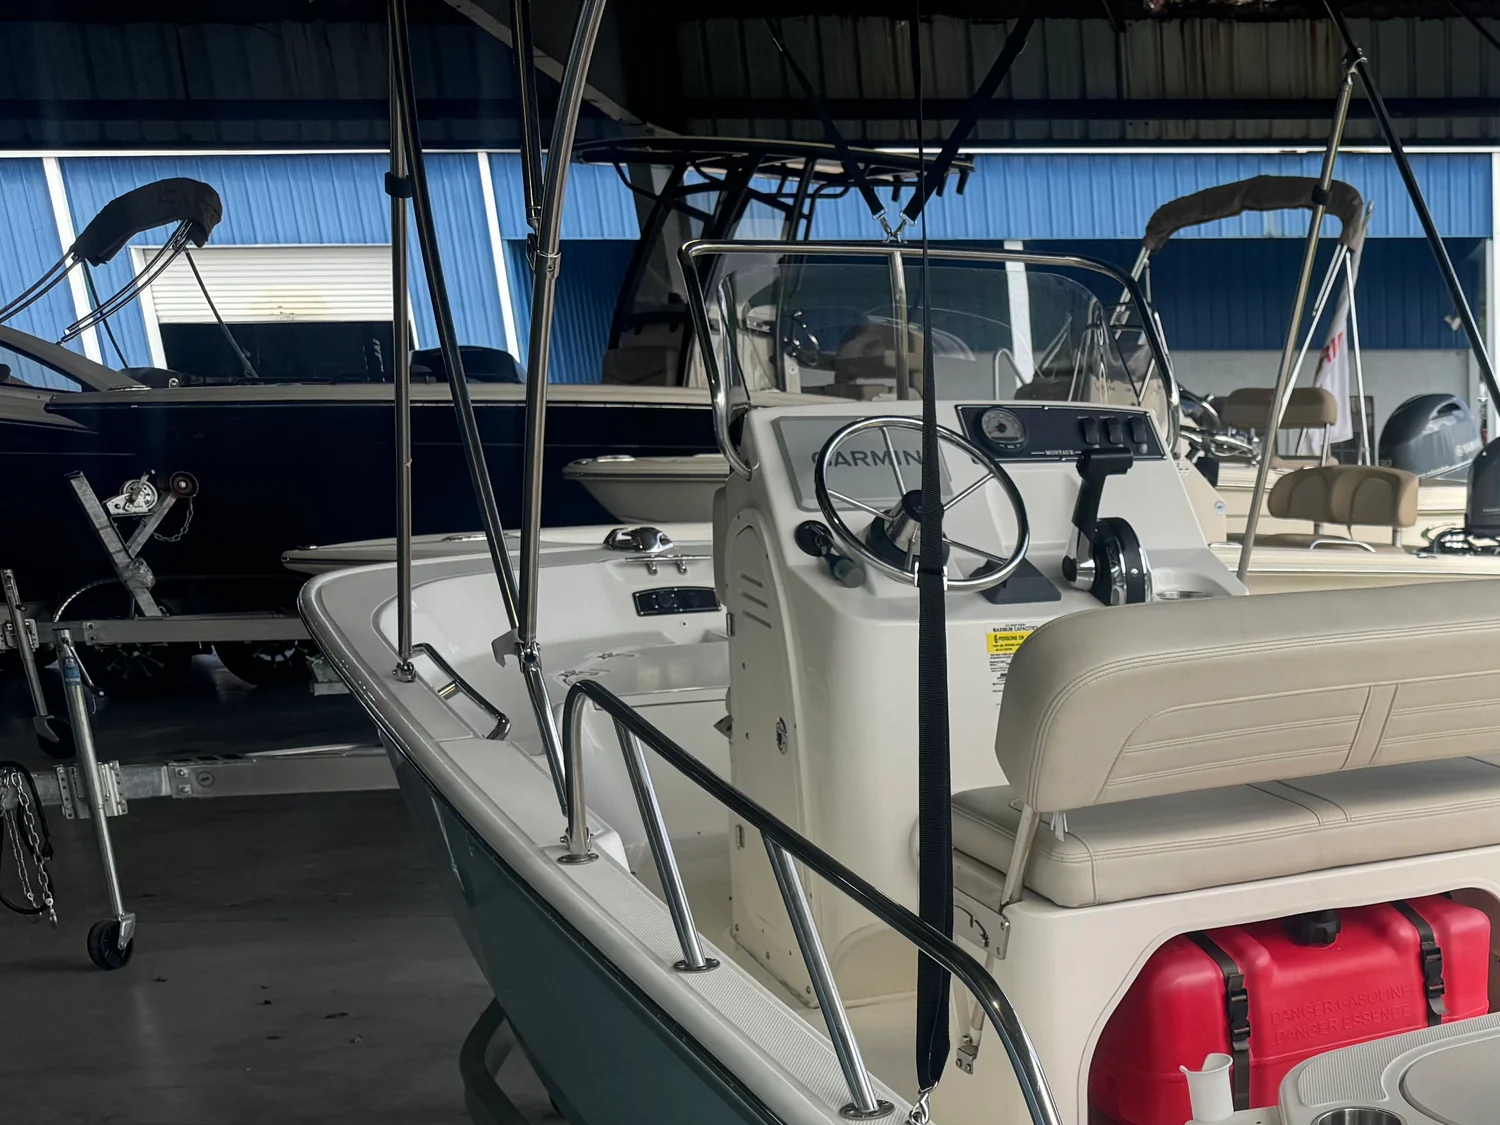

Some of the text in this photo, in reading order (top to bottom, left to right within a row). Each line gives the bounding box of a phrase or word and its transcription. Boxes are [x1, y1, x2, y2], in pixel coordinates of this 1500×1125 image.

[1270, 984, 1412, 1025] DANGER GASOLINE
[1275, 1004, 1413, 1044] DANGER ESSENCE
